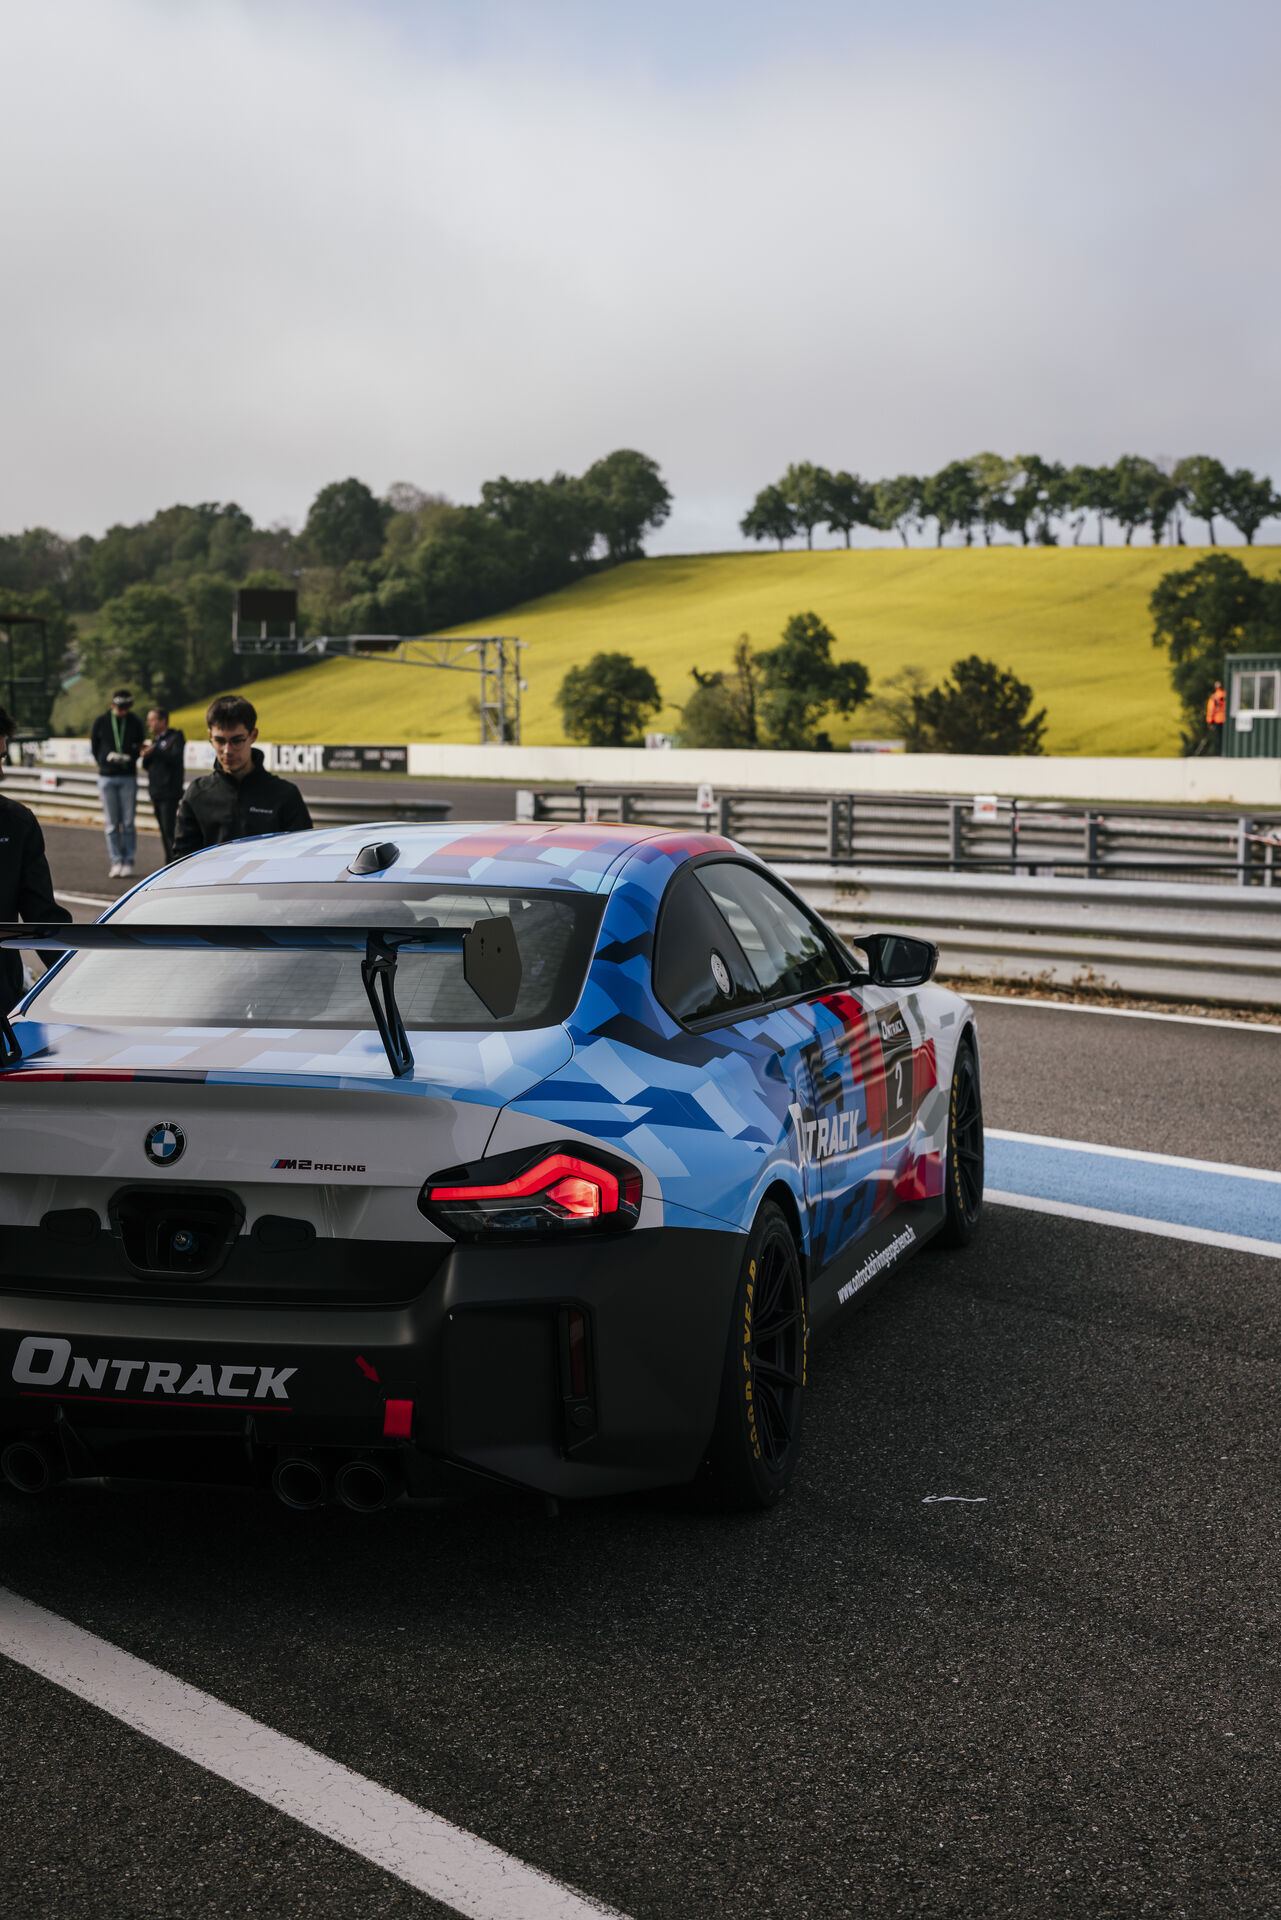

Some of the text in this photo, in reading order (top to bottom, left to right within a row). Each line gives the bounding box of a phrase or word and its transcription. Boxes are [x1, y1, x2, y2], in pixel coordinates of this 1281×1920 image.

[272, 744, 324, 772] LEICHT
[895, 1061, 903, 1109] 2
[314, 1163, 366, 1172] RACING
[743, 1258, 761, 1460] GOODYEAR
